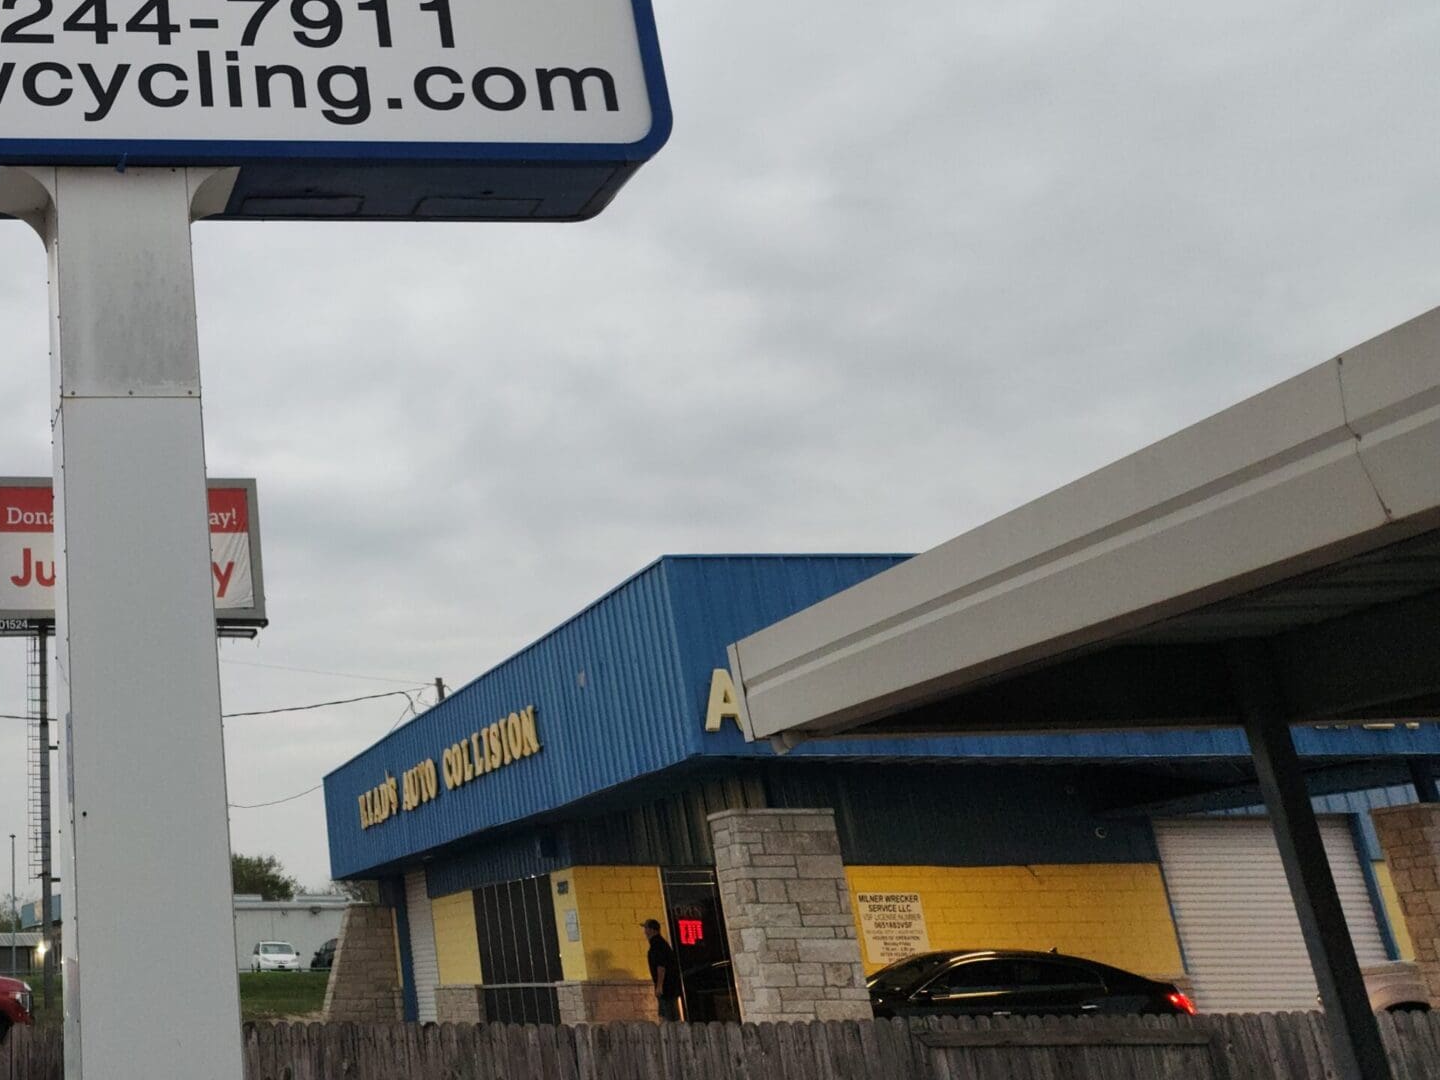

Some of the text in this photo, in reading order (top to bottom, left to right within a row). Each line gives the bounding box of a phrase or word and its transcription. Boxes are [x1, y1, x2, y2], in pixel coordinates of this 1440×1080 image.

[705, 668, 746, 733] A
[402, 758, 438, 811] AUTO
[442, 705, 542, 790] COLLISION
[858, 895, 919, 903] MILNER WRECKER
[868, 904, 897, 912] SERVICE
